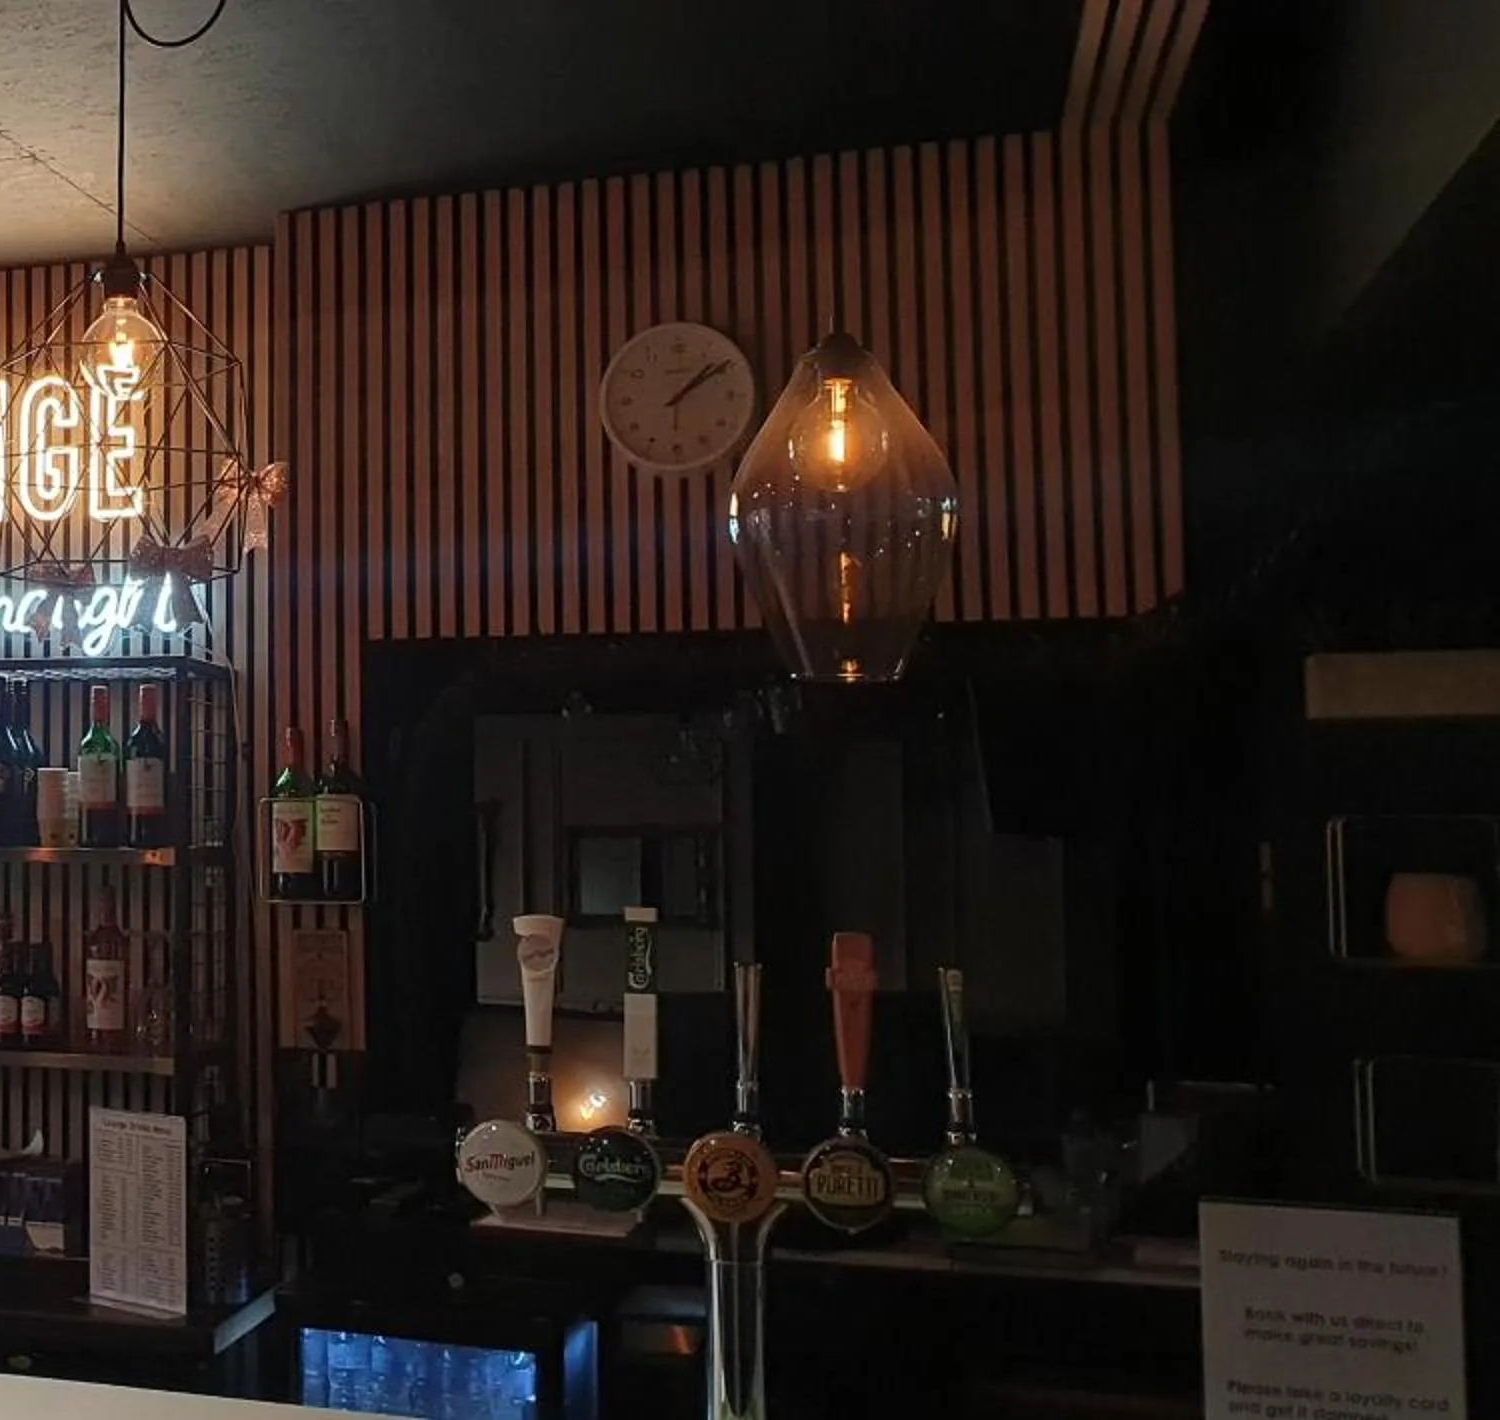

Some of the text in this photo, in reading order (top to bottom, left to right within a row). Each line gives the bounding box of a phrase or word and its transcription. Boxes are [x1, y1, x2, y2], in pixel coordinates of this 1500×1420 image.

[1356, 1260, 1384, 1274] the
[1291, 1311, 1326, 1327] with
[1330, 1315, 1349, 1328] us
[1407, 1319, 1425, 1334] to
[1227, 1379, 1282, 1396] Please
[1328, 1390, 1342, 1402] a
[1407, 1397, 1449, 1412] card
[1228, 1401, 1261, 1415] and
[1265, 1403, 1293, 1419] get
